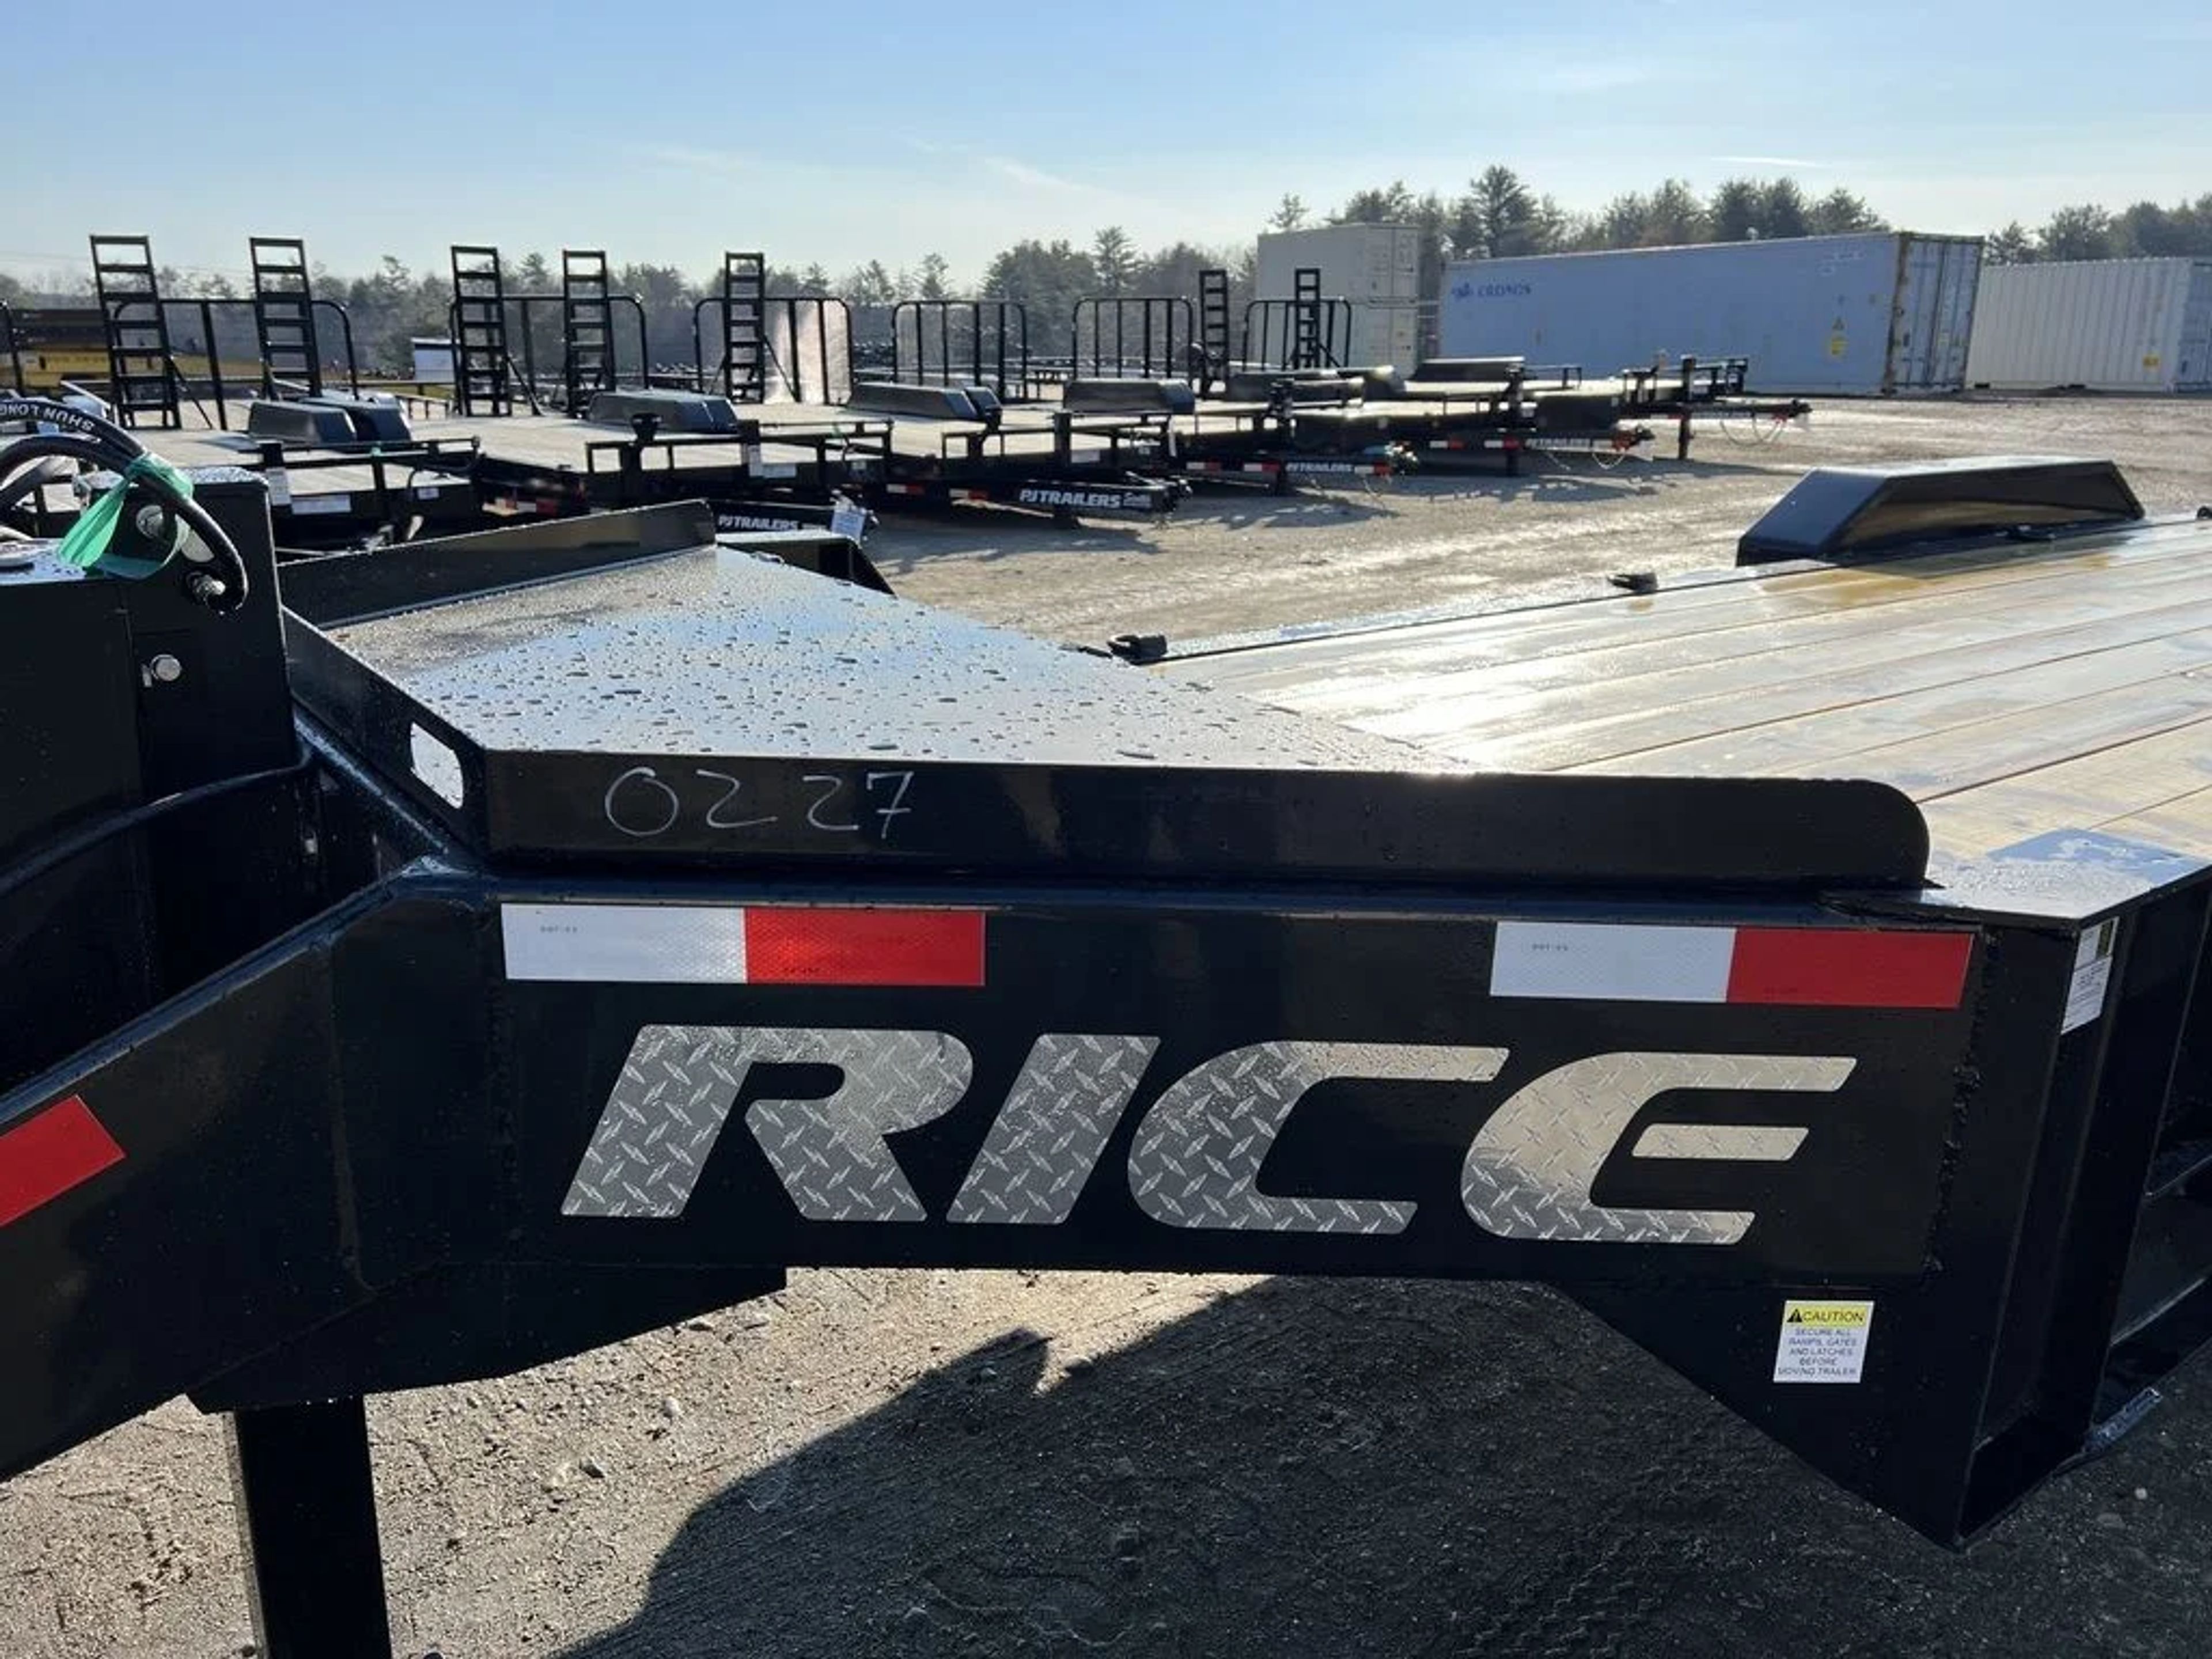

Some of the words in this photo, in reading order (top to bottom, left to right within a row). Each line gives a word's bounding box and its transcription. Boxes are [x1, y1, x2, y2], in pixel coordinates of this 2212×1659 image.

[43, 407, 95, 431] SHUN
[561, 1024, 1858, 1246] RICE
[1803, 1310, 1865, 1323] CAUTION
[1827, 1338, 1857, 1346] GATES
[1790, 1347, 1809, 1355] AND
[1810, 1347, 1853, 1355] LATCHES
[1799, 1357, 1838, 1366] BEFORE
